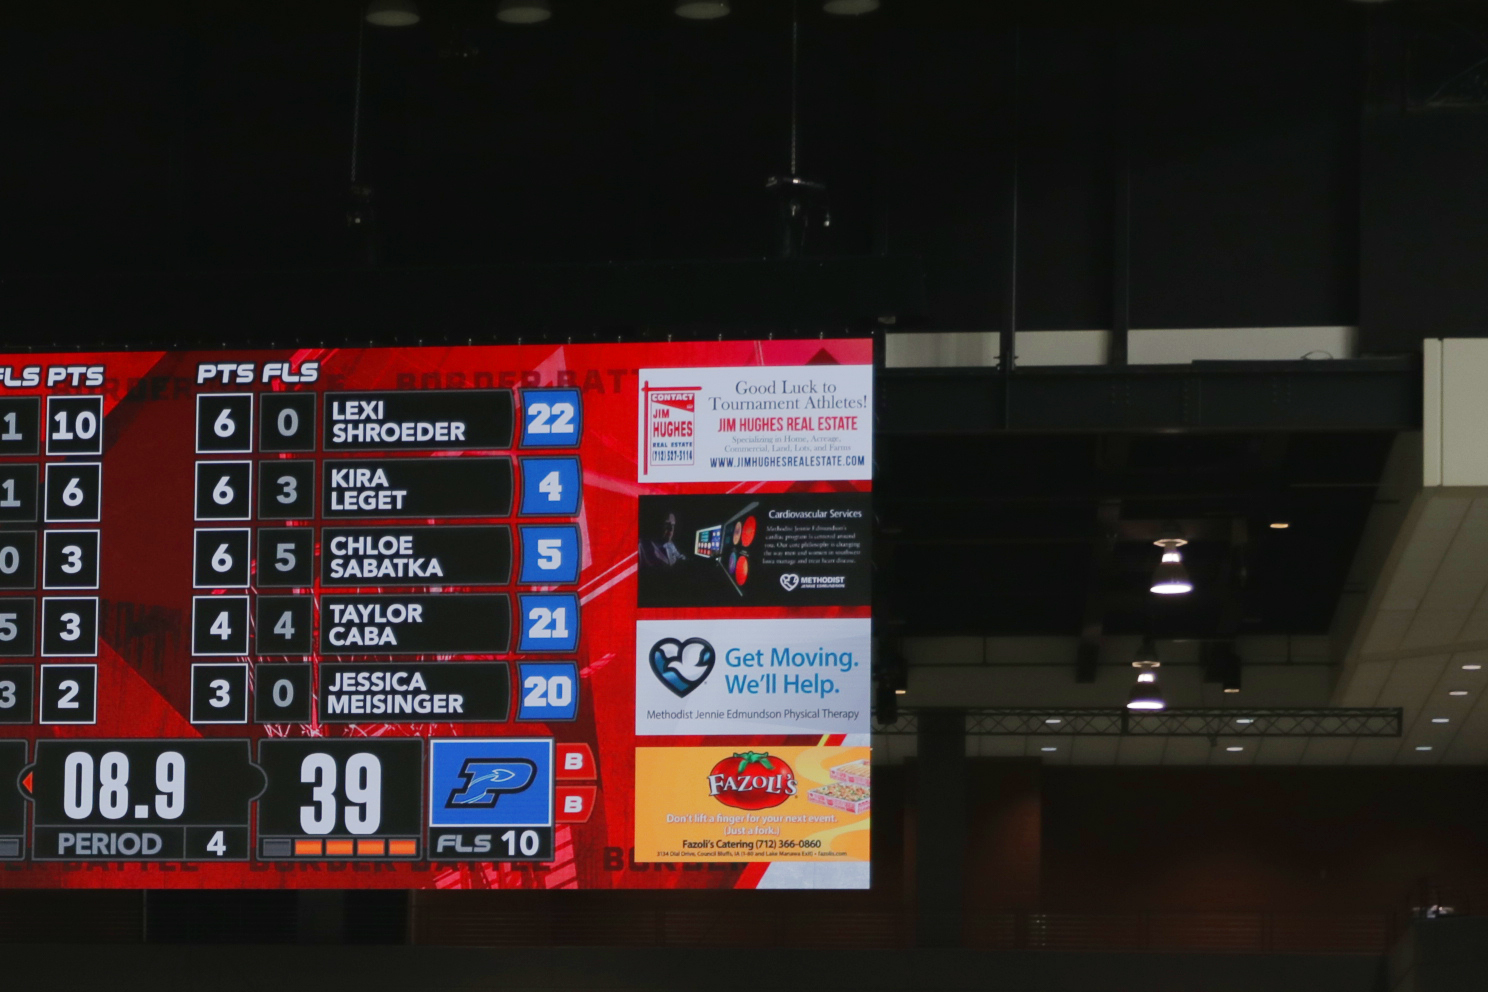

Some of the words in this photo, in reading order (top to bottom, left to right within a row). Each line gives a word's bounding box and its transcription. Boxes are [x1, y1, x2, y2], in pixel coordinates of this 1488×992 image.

[47, 367, 104, 386] PTS
[197, 364, 254, 384] PTS
[262, 363, 319, 382] FLS
[652, 393, 694, 401] CONTACT
[735, 380, 776, 395] Good
[782, 380, 818, 394] Luck
[822, 381, 837, 394] to
[332, 401, 384, 420] LEXI
[653, 408, 670, 419] JIM
[708, 396, 799, 411] Tournament
[804, 395, 867, 409] Athletes!
[1, 412, 23, 440] 1
[51, 411, 97, 440] 10
[214, 408, 235, 438] 6
[277, 408, 299, 437] 0
[527, 403, 574, 434] 22
[653, 421, 693, 438] HUGHES
[717, 418, 736, 433] JIM
[739, 417, 784, 432] HUGHES
[787, 416, 815, 431] REAL
[818, 416, 858, 431] ESTATE
[332, 422, 466, 442] SHROEDER
[709, 455, 865, 468] WWW.JIMHUGHESREALESTATE.COM
[212, 476, 234, 505] 6
[276, 476, 298, 504] 3
[331, 468, 389, 488] KIRA
[538, 471, 562, 501] 4
[0, 479, 21, 507] 1
[62, 478, 84, 506] 6
[331, 490, 407, 510] LEGET
[768, 509, 828, 519] Cardiovascular
[829, 509, 862, 518] Services
[275, 543, 296, 571] 5
[330, 536, 413, 555] CHLOE
[537, 539, 562, 570] 5
[61, 545, 82, 574] 3
[211, 544, 233, 573] 6
[330, 558, 443, 578] SABATKA
[801, 576, 845, 584] METHODIST
[59, 612, 81, 641] 3
[210, 611, 232, 640] 4
[273, 611, 295, 639] 4
[330, 604, 423, 624] TAYLOR
[528, 607, 568, 638] 21
[329, 626, 397, 647] CABA
[725, 647, 764, 668] Get
[770, 647, 859, 672] Moving.
[58, 679, 79, 709] 2
[209, 679, 230, 708] 3
[272, 678, 294, 707] 0
[329, 672, 427, 692] JESSICA
[523, 675, 572, 707] 20
[725, 674, 777, 694] We'll
[783, 673, 840, 698] Help.
[327, 694, 463, 714] MEISINGER
[646, 710, 693, 720] Methodist
[695, 709, 725, 720] Jennie
[726, 709, 782, 719] Edmundson
[784, 709, 820, 720] Physical
[821, 708, 859, 721] Therapy
[564, 753, 584, 770] B
[63, 751, 186, 820] 08.9
[300, 752, 382, 835] 39
[564, 796, 583, 813] B
[666, 813, 693, 823] Don't
[694, 814, 707, 823] lift
[716, 813, 745, 824] finger
[746, 813, 761, 823] for
[761, 816, 784, 825] your
[785, 814, 807, 823] next
[808, 814, 838, 823] event.
[723, 826, 746, 836] (Just
[754, 825, 781, 836] fork.)
[57, 833, 163, 855] PERIOD
[206, 830, 227, 856] 4
[436, 835, 492, 853] FLS
[500, 830, 539, 855] 10
[682, 839, 715, 849] Fazoli's
[716, 839, 754, 850] Catering
[755, 839, 776, 850] (712)
